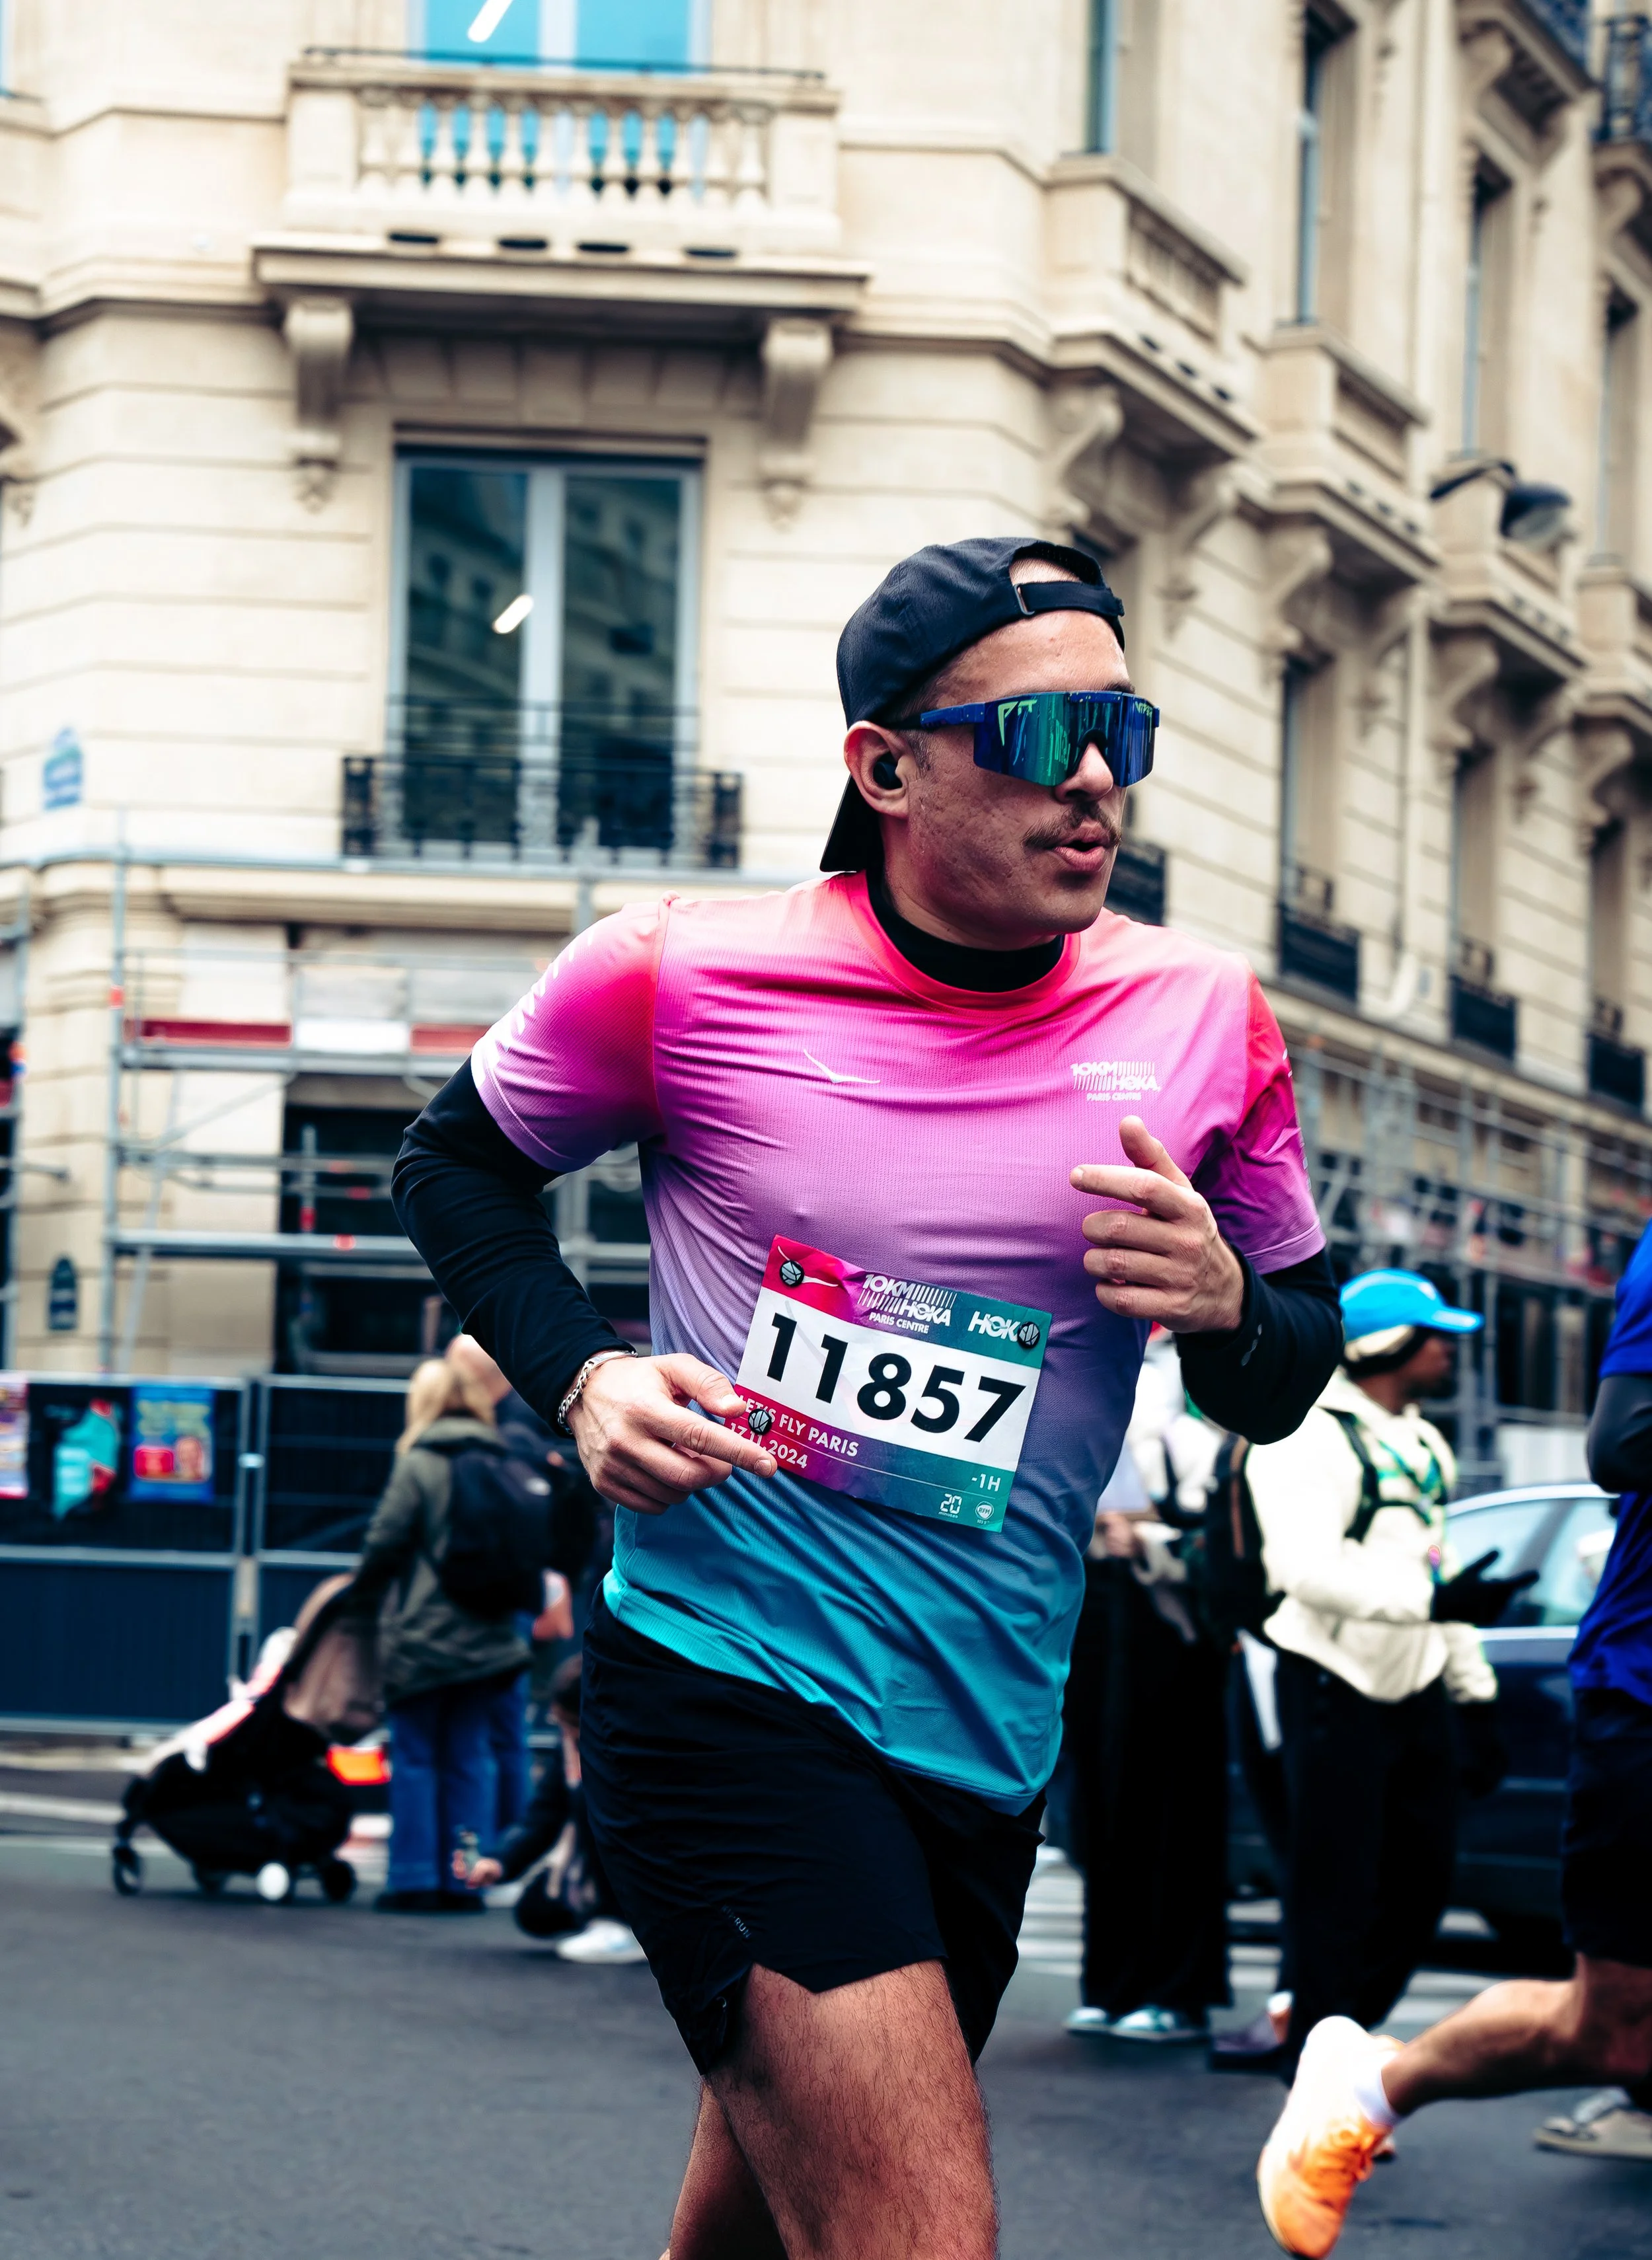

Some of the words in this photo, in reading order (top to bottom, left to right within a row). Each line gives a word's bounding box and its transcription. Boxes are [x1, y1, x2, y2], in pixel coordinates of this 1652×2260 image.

[1070, 1061, 1119, 1076] 10KM
[1112, 1075, 1159, 1091] HOKA
[862, 1274, 917, 1300] 10KM
[868, 1312, 895, 1326] PARIS
[896, 1318, 930, 1334] CENTRE
[899, 1299, 952, 1327] HOKA
[967, 1311, 1021, 1342] HOK
[765, 1312, 1028, 1443] 11857
[731, 1422, 808, 1469] 1711.2024
[779, 1413, 807, 1436] FLY
[808, 1427, 860, 1457] PARIS
[940, 1493, 963, 1515] 20
